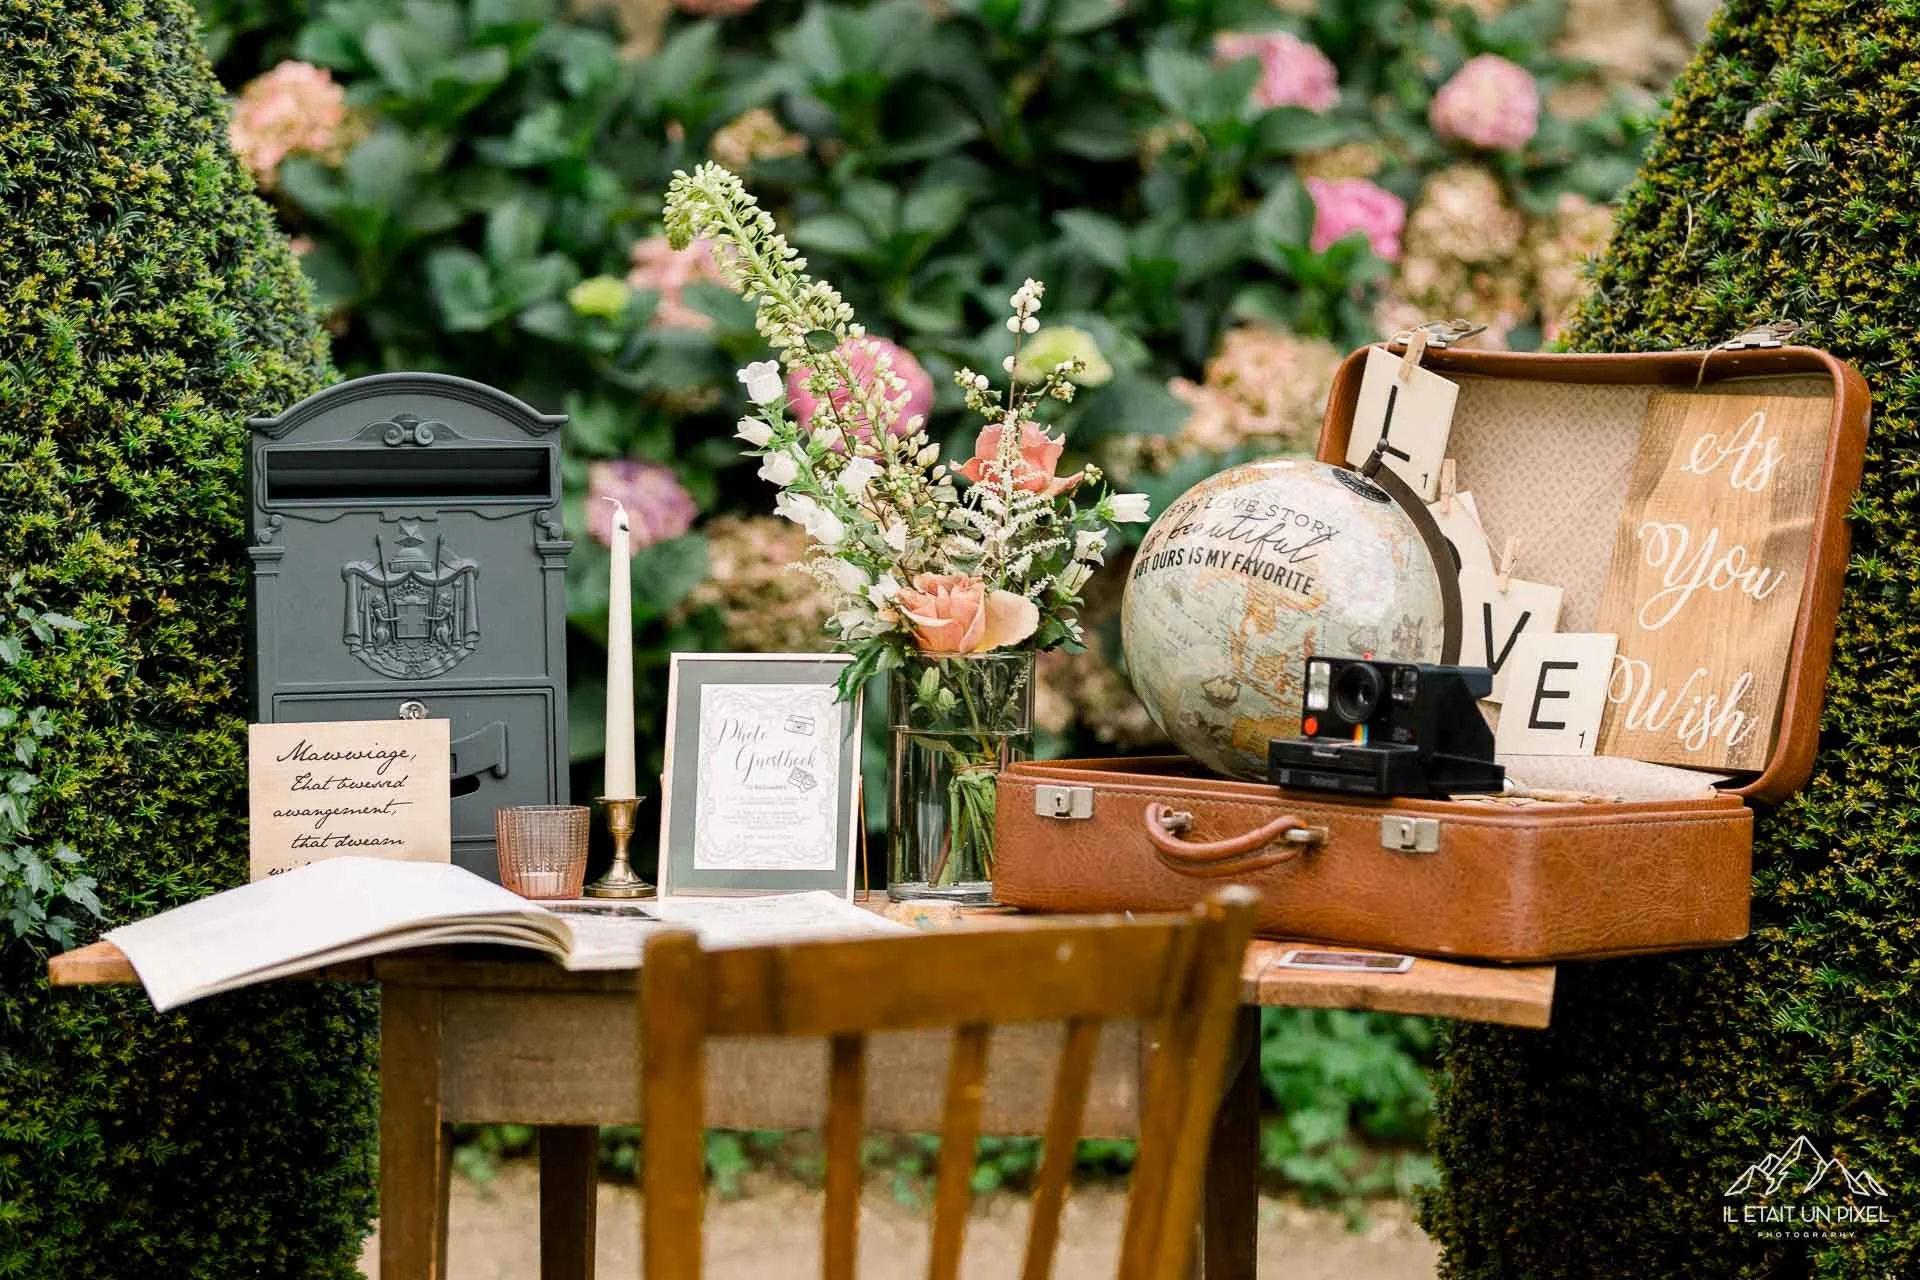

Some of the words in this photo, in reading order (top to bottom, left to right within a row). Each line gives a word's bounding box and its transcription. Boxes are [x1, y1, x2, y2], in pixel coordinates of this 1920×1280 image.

[1380, 384, 1410, 463] L
[1680, 411, 1786, 492] As
[1421, 472, 1430, 490] 1
[1166, 503, 1337, 565] beautiful
[1204, 495, 1260, 513] LOVE
[1266, 504, 1341, 541] STORY
[1152, 547, 1185, 571] OURS
[1188, 546, 1204, 566] IS
[1206, 549, 1232, 570] MY
[1231, 553, 1315, 596] FAVORITE
[1638, 521, 1787, 631] You
[1483, 602, 1532, 675] V
[1528, 661, 1579, 730] E
[1607, 654, 1760, 752] Wish
[276, 739, 417, 776] Mawwiage,
[1577, 730, 1587, 748] 1
[291, 772, 338, 791] That
[273, 799, 414, 830] awangement,
[291, 833, 338, 849] that
[335, 834, 406, 849] dweam
